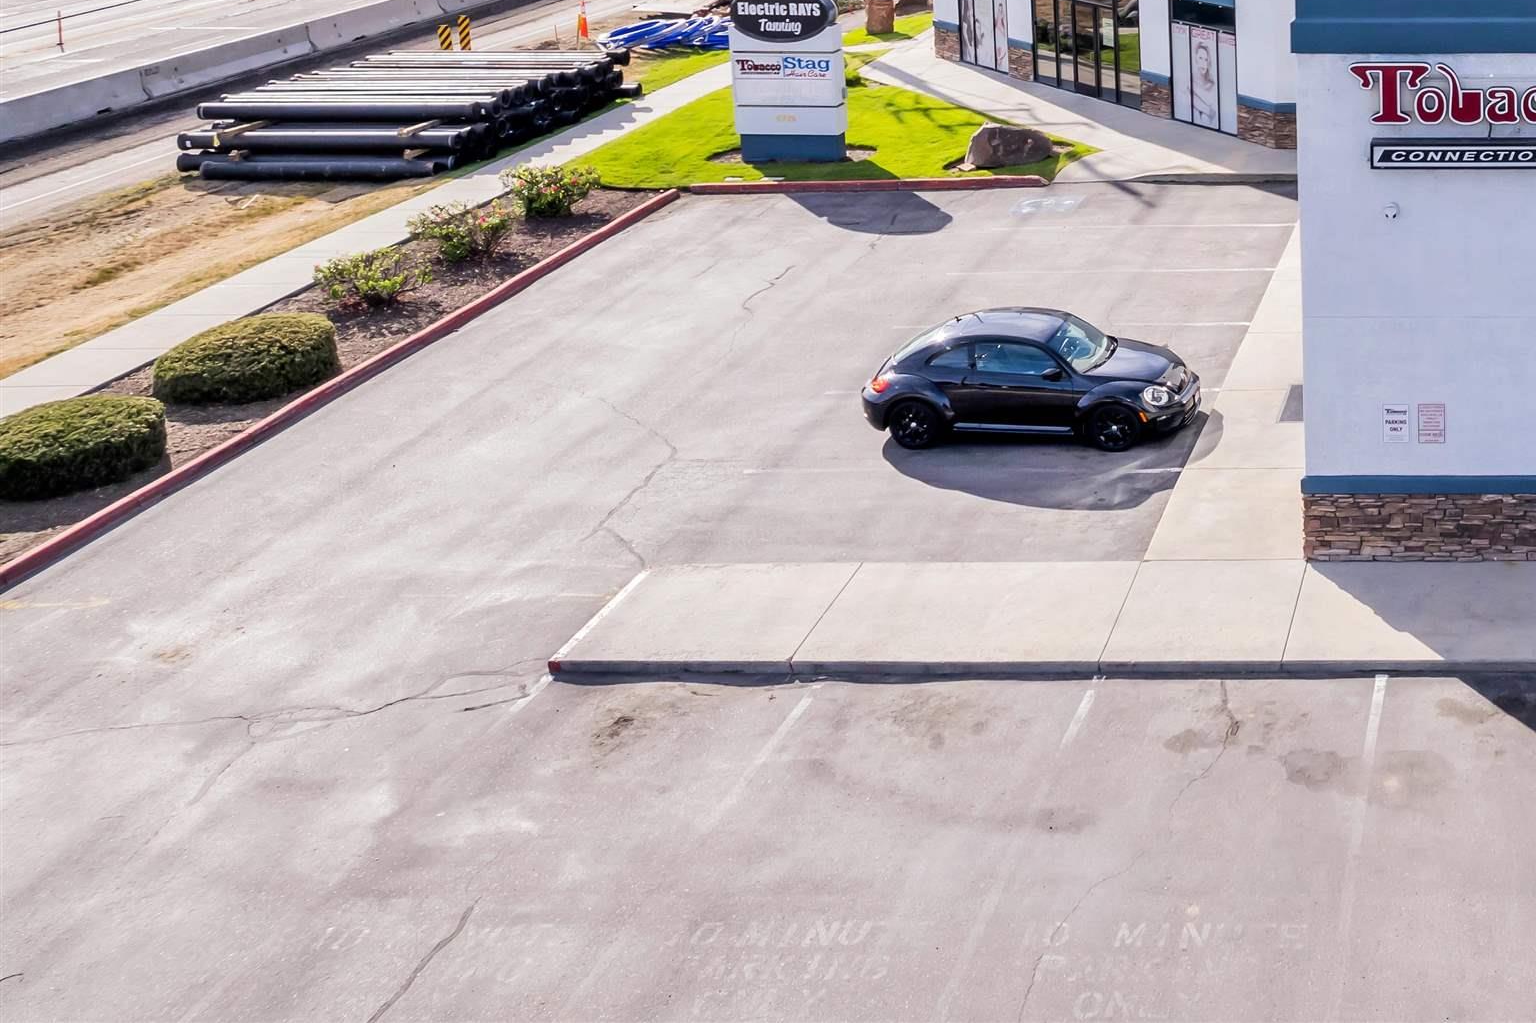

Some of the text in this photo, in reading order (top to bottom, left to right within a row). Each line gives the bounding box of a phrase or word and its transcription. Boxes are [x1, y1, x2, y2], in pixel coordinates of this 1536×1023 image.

[737, 1, 821, 17] Electric RAYS
[758, 19, 802, 35] Tanning
[784, 57, 832, 73] Stag
